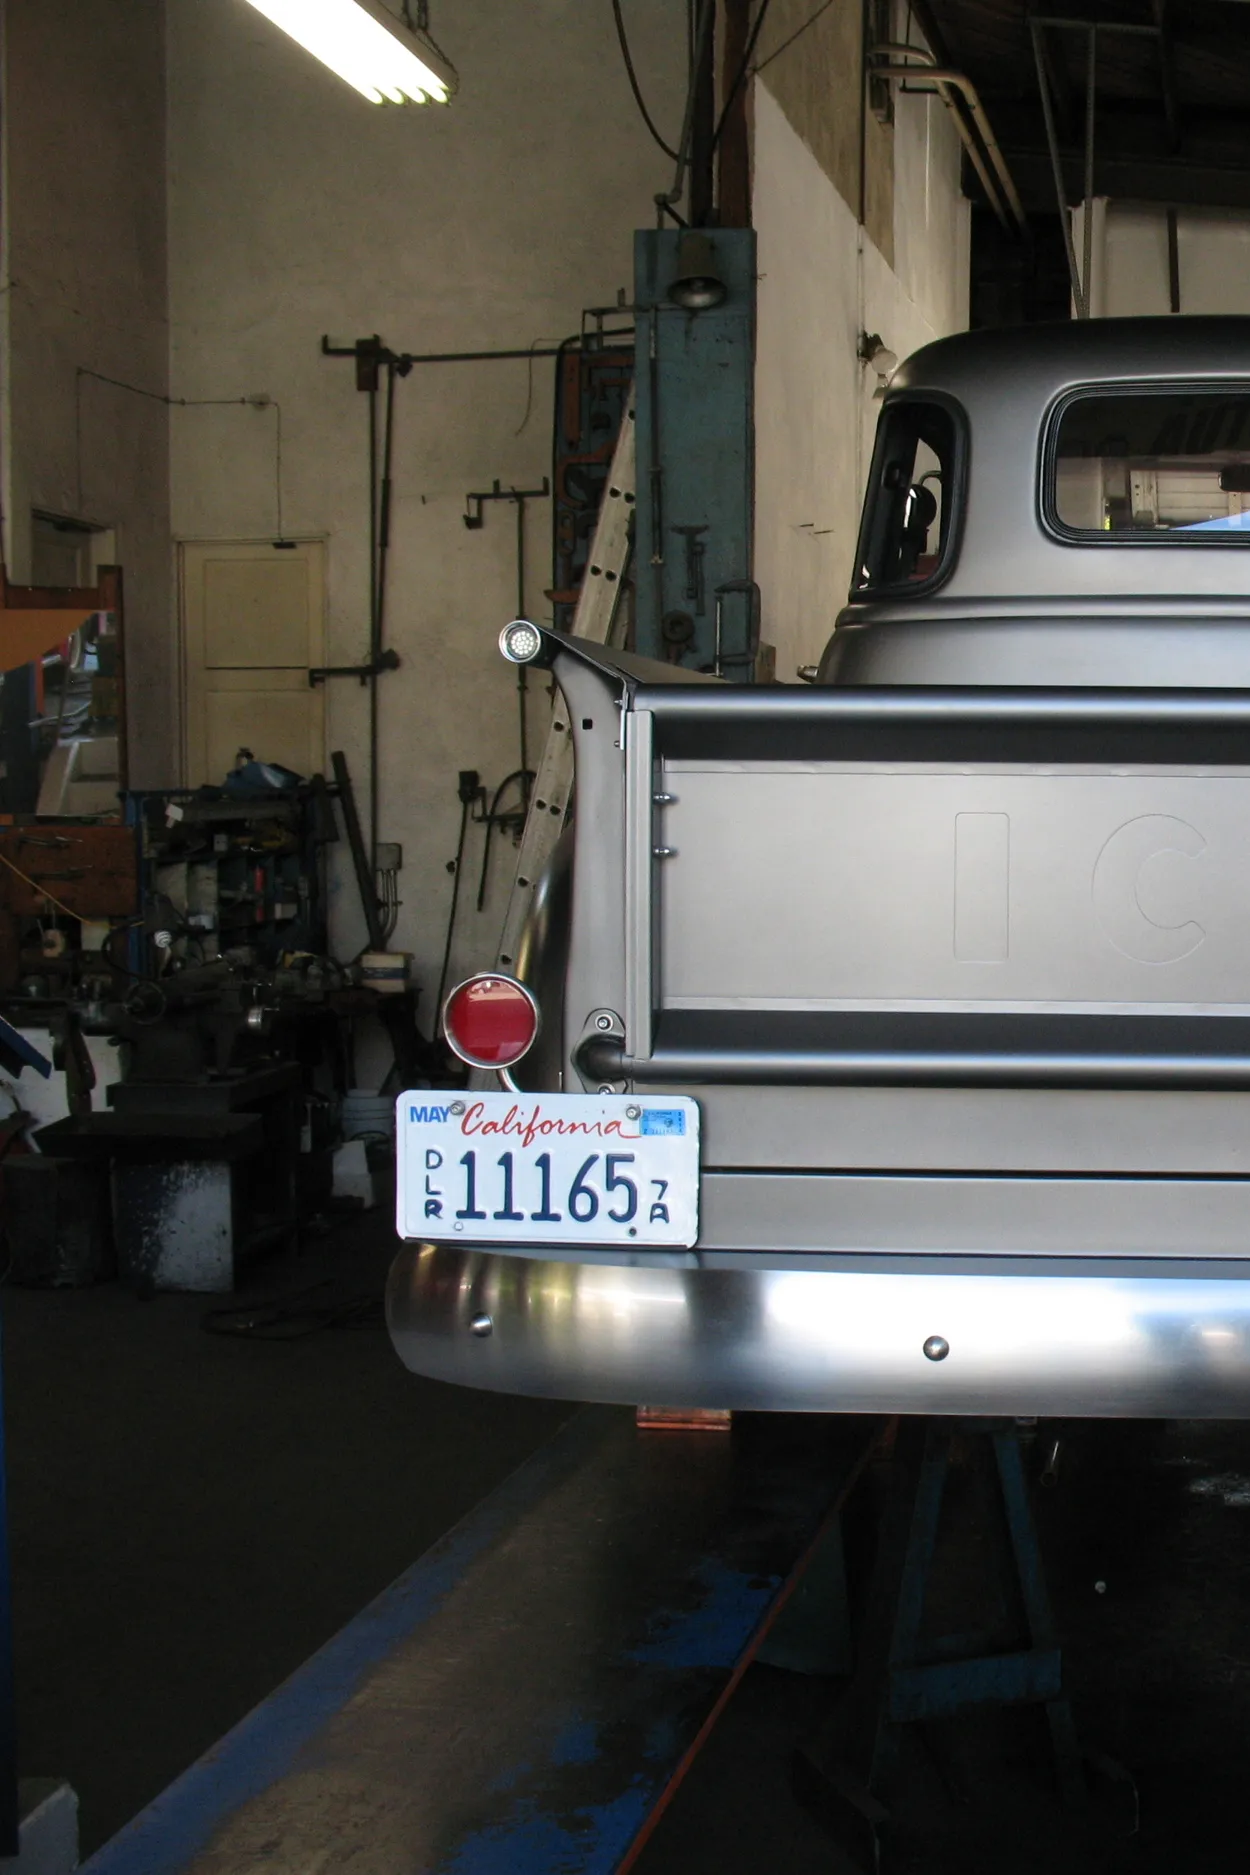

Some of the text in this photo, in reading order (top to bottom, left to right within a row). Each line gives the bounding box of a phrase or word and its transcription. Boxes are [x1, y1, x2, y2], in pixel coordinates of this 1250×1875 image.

[410, 1106, 450, 1122] MAY
[461, 1102, 642, 1147] California
[456, 1151, 638, 1223] 11165
